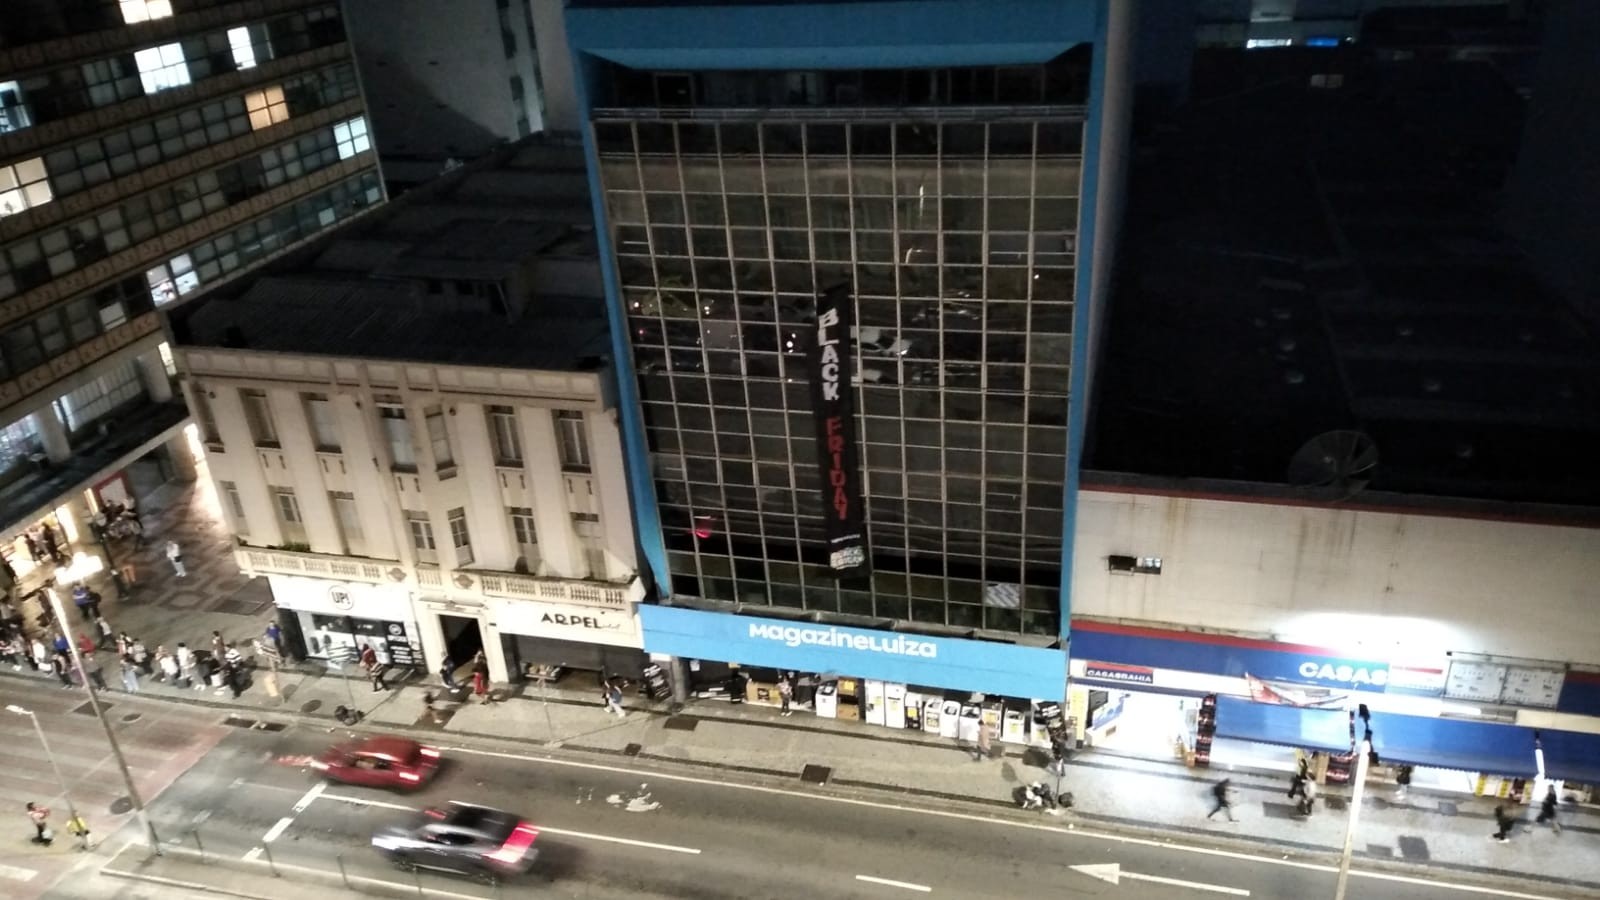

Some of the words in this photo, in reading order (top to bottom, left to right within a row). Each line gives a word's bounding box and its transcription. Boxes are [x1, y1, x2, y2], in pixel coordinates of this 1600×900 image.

[817, 307, 840, 401] BLACK
[826, 417, 847, 521] FRIDAY
[541, 612, 601, 629] ARPEL
[1299, 662, 1388, 686] CASAS
